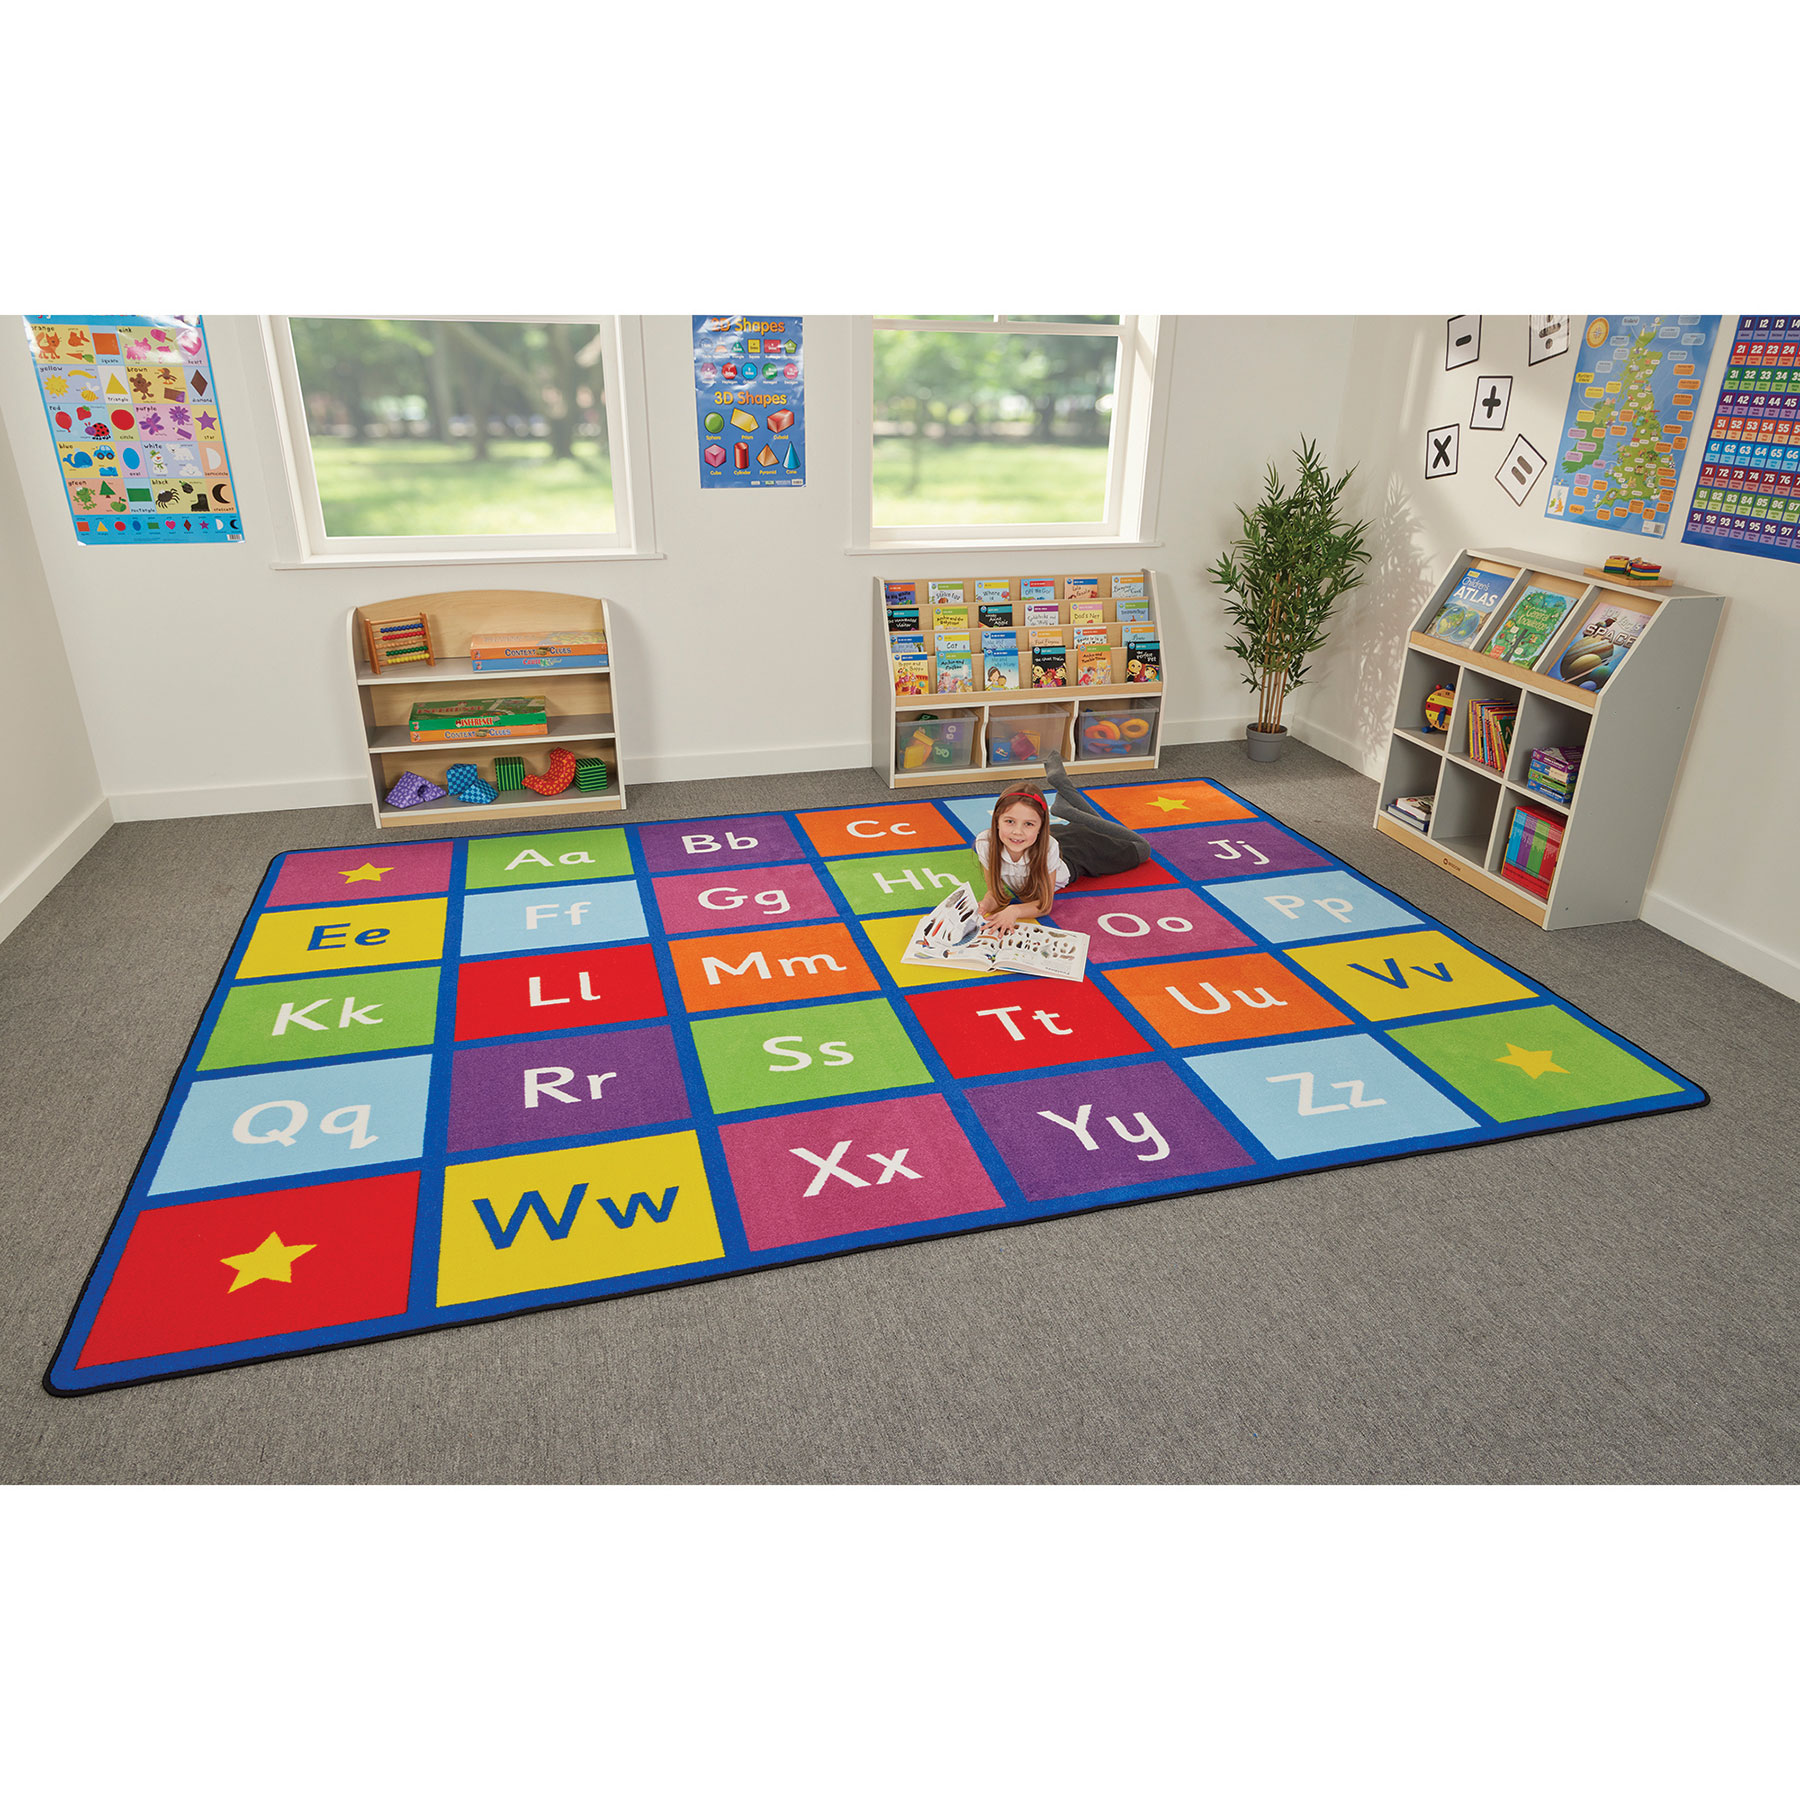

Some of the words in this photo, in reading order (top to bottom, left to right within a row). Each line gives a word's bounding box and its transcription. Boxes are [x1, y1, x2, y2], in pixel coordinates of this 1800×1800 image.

[711, 317, 731, 332] 2D
[735, 317, 785, 335] Shapes
[1744, 319, 1752, 328] 11
[1759, 319, 1769, 328] 12
[1775, 319, 1785, 328] 13
[1736, 345, 1746, 354] 21
[1751, 345, 1763, 354] 22
[1766, 345, 1779, 354] 23
[1782, 346, 1795, 354] 24
[40, 366, 63, 374] yellow
[1730, 370, 1739, 379] 31
[1744, 370, 1756, 379] 32
[1760, 371, 1771, 380] 33
[1775, 371, 1788, 380] 34
[714, 391, 734, 405] 3D
[737, 391, 788, 408] Shapes
[1723, 395, 1733, 404] 41
[1737, 395, 1749, 404] 42
[1753, 396, 1765, 405] 43
[1768, 397, 1781, 406] 44
[1785, 398, 1797, 407] 45
[1717, 419, 1726, 428] 51
[1731, 420, 1743, 429] 52
[1746, 421, 1758, 430] 53
[1762, 422, 1774, 431] 54
[1777, 423, 1790, 433] 55
[1710, 443, 1720, 451] 61
[1724, 444, 1735, 453] 62
[1739, 446, 1751, 454] 63
[1755, 448, 1767, 456] 64
[1770, 449, 1782, 458] 65
[1786, 450, 1799, 459] 66
[68, 480, 87, 488] green
[1704, 467, 1713, 475] 71
[1718, 468, 1729, 477] 72
[1733, 470, 1744, 479] 73
[1749, 472, 1759, 481] 74
[1764, 474, 1775, 482] 75
[1780, 476, 1790, 484] 76
[1698, 490, 1707, 499] 81
[1712, 492, 1723, 501] 82
[1726, 494, 1738, 503] 83
[1741, 496, 1753, 505] 84
[1756, 498, 1768, 507] 85
[1771, 500, 1784, 509] 86
[1788, 502, 1800, 511] 87
[1693, 513, 1702, 521] 91
[1706, 515, 1716, 524] 92
[1720, 517, 1731, 526] 93
[1734, 520, 1746, 529] 94
[1749, 522, 1761, 531] 95
[1764, 525, 1776, 533] 96
[1781, 527, 1793, 536] 97
[1461, 577, 1490, 591] Children's
[1453, 585, 1498, 607] ATLAS
[1518, 614, 1548, 632] Knowledge
[1526, 607, 1550, 622] General
[1583, 623, 1638, 649] SPACE
[504, 648, 536, 657] CONTEXT
[549, 646, 572, 655] CLUES
[461, 717, 494, 726] INFERENCE
[444, 731, 476, 739] CONTEXT
[489, 728, 511, 736] CLUES
[847, 821, 916, 837] Cc
[682, 832, 758, 853] Bb
[1208, 840, 1269, 864] Jj
[505, 850, 595, 870] Aa
[873, 867, 961, 894] Hh
[698, 888, 790, 914] Gg
[1264, 895, 1353, 922] Pp
[526, 902, 591, 929] Ff
[1098, 913, 1193, 937] Oo
[307, 923, 390, 951] Ee
[702, 952, 846, 985] Mm
[1348, 958, 1453, 989] Vv
[529, 972, 600, 1006] Ll
[1165, 983, 1288, 1014] Uu
[272, 997, 383, 1035] Kk
[976, 1006, 1073, 1041] Tt
[763, 1036, 853, 1071] Ss
[524, 1067, 616, 1108] Rr
[1266, 1072, 1386, 1116] Zz
[233, 1100, 378, 1149] Qq
[1037, 1105, 1170, 1161] Yy
[789, 1140, 923, 1197] Xx
[472, 1183, 679, 1249] Ww
